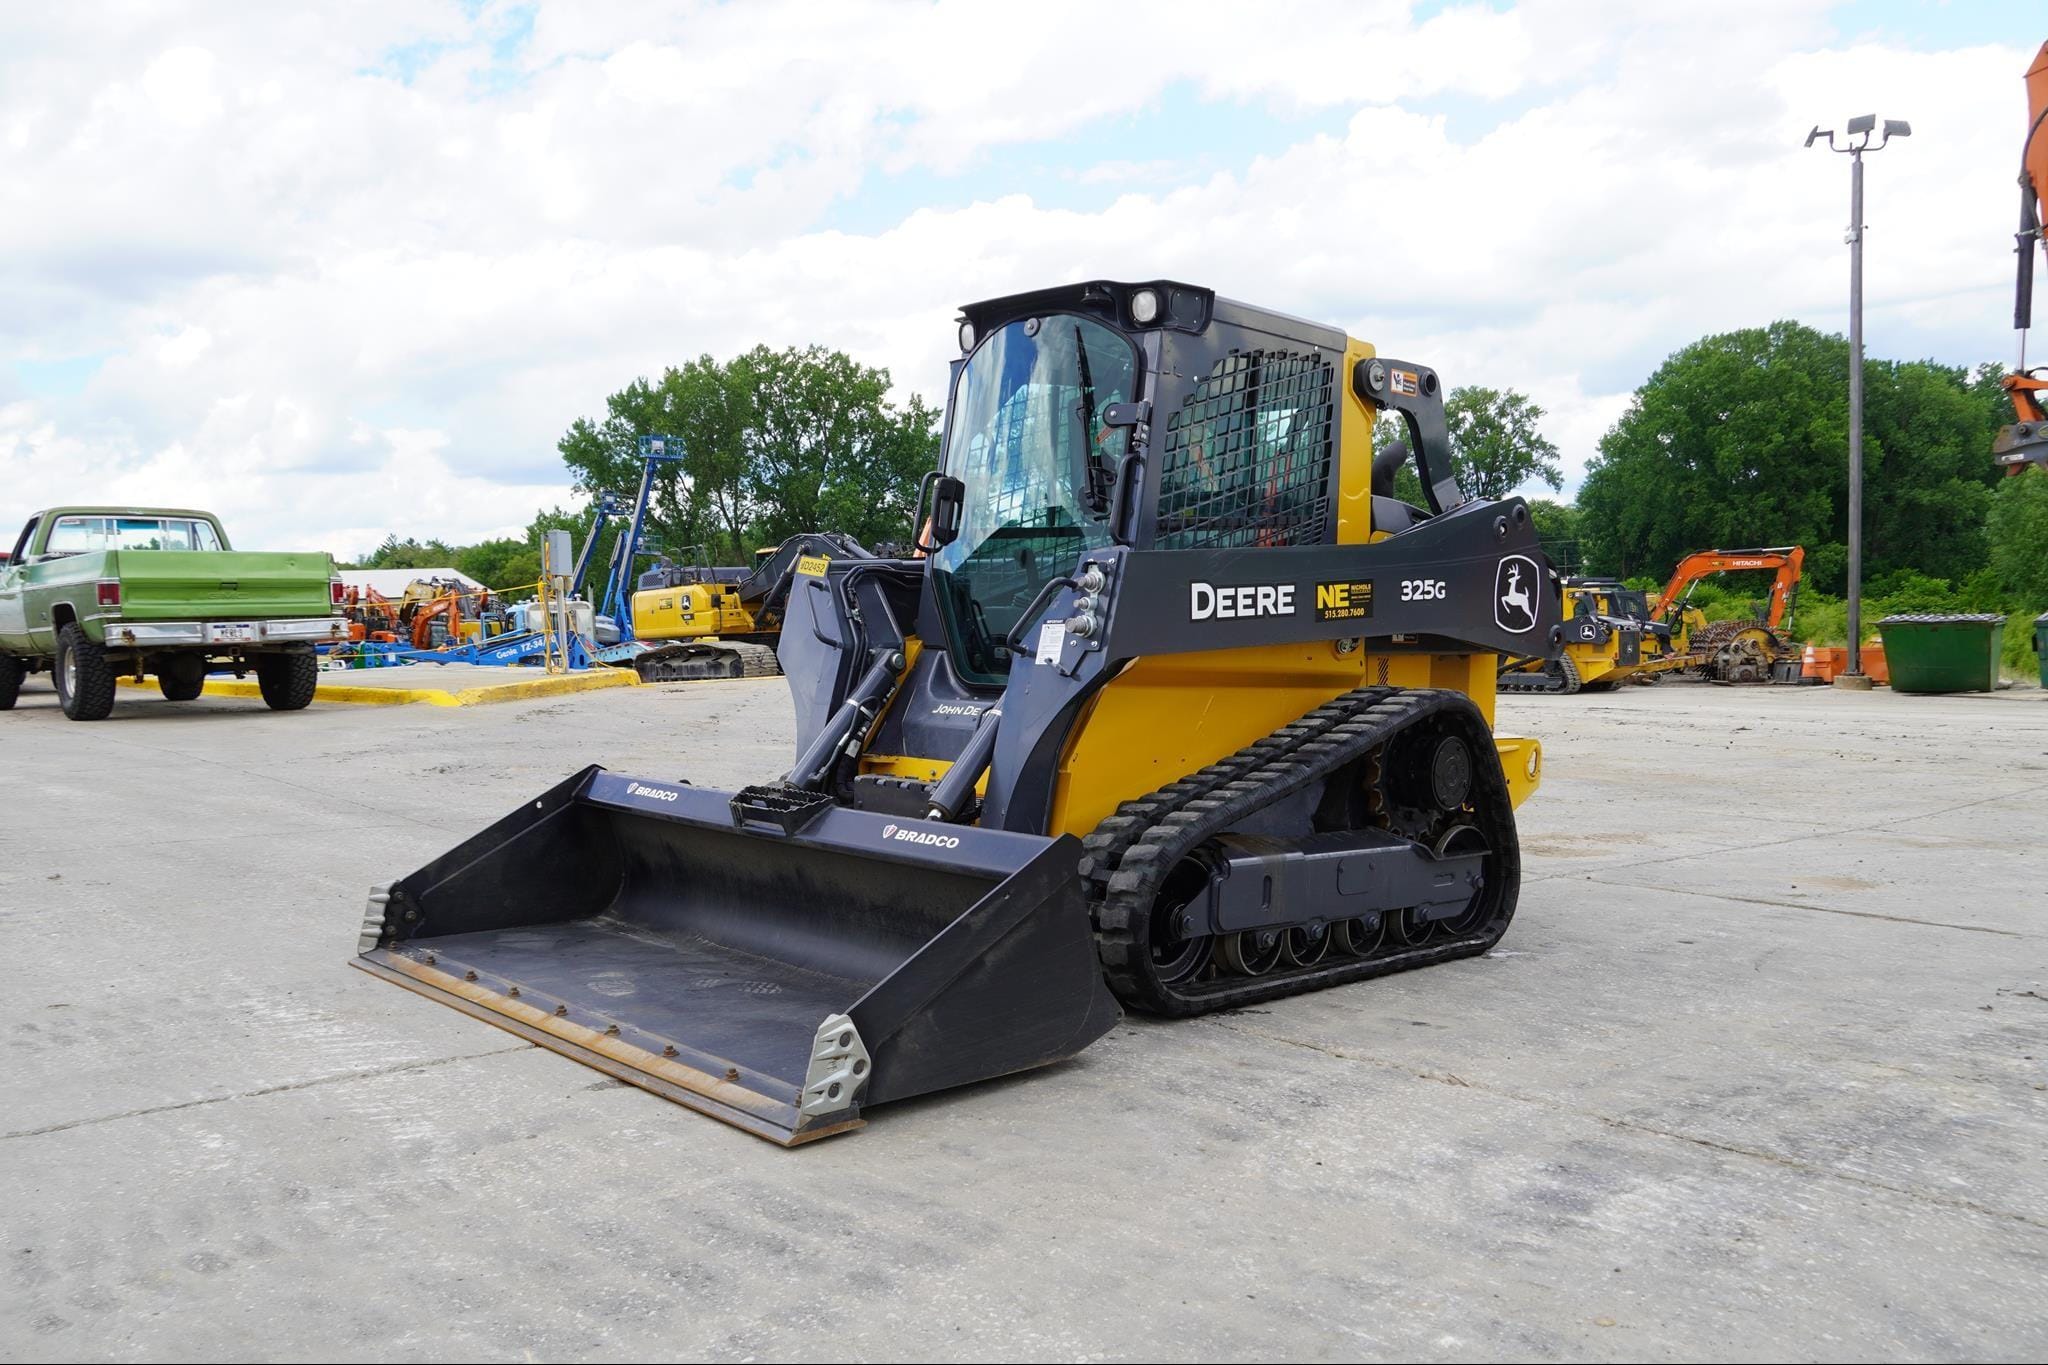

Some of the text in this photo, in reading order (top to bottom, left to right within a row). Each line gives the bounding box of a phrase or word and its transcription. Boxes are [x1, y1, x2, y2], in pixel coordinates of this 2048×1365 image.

[1317, 583, 1350, 609] NE
[1401, 579, 1446, 601] 325G
[1191, 582, 1295, 620] DEERE
[1324, 607, 1365, 619] 515.280.7600
[496, 648, 519, 659] Genie
[932, 704, 963, 714] JOHN
[634, 786, 678, 801] BRADCO
[894, 829, 960, 849] BRADCO
